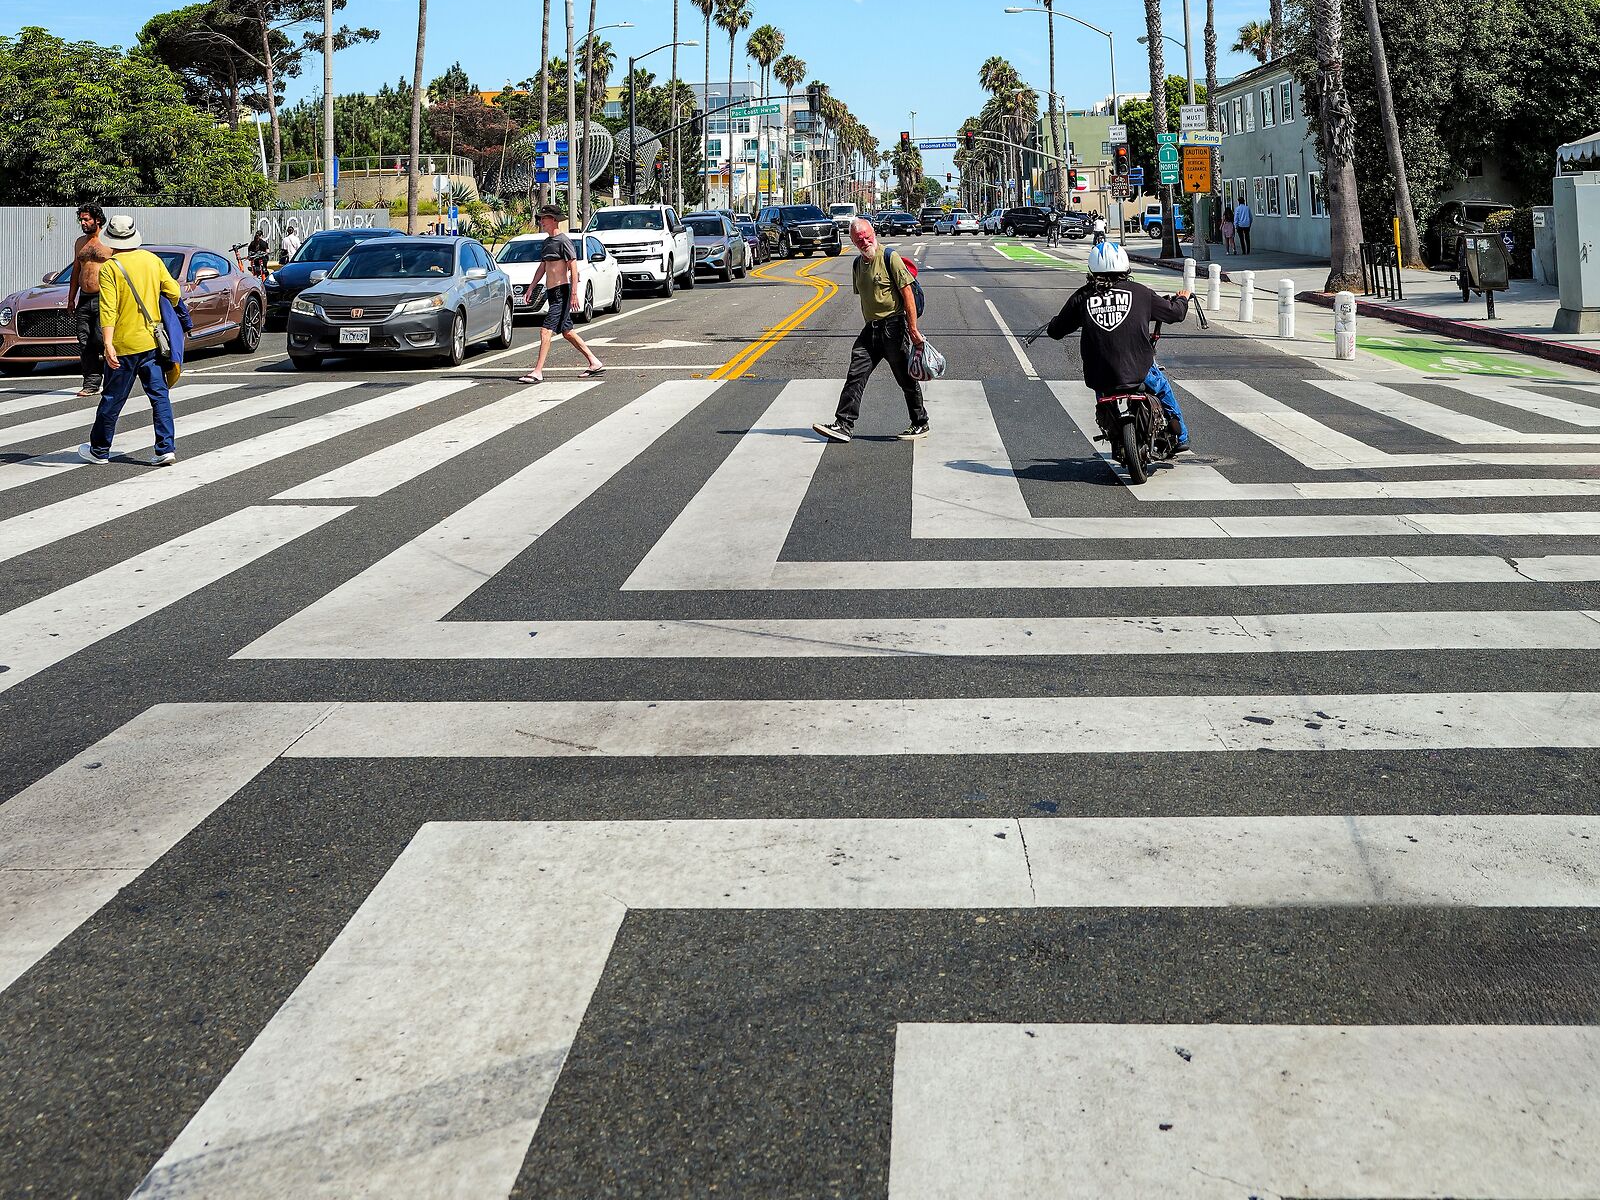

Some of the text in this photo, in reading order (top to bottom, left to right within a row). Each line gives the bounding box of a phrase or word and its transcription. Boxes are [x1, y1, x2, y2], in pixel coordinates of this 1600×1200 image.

[1194, 134, 1220, 144] Parking
[1166, 151, 1170, 160] 1
[331, 213, 376, 230] PARK
[1090, 294, 1129, 307] DTM
[1091, 304, 1128, 314] MOTORIZED BIKE
[1096, 311, 1122, 327] CLUB
